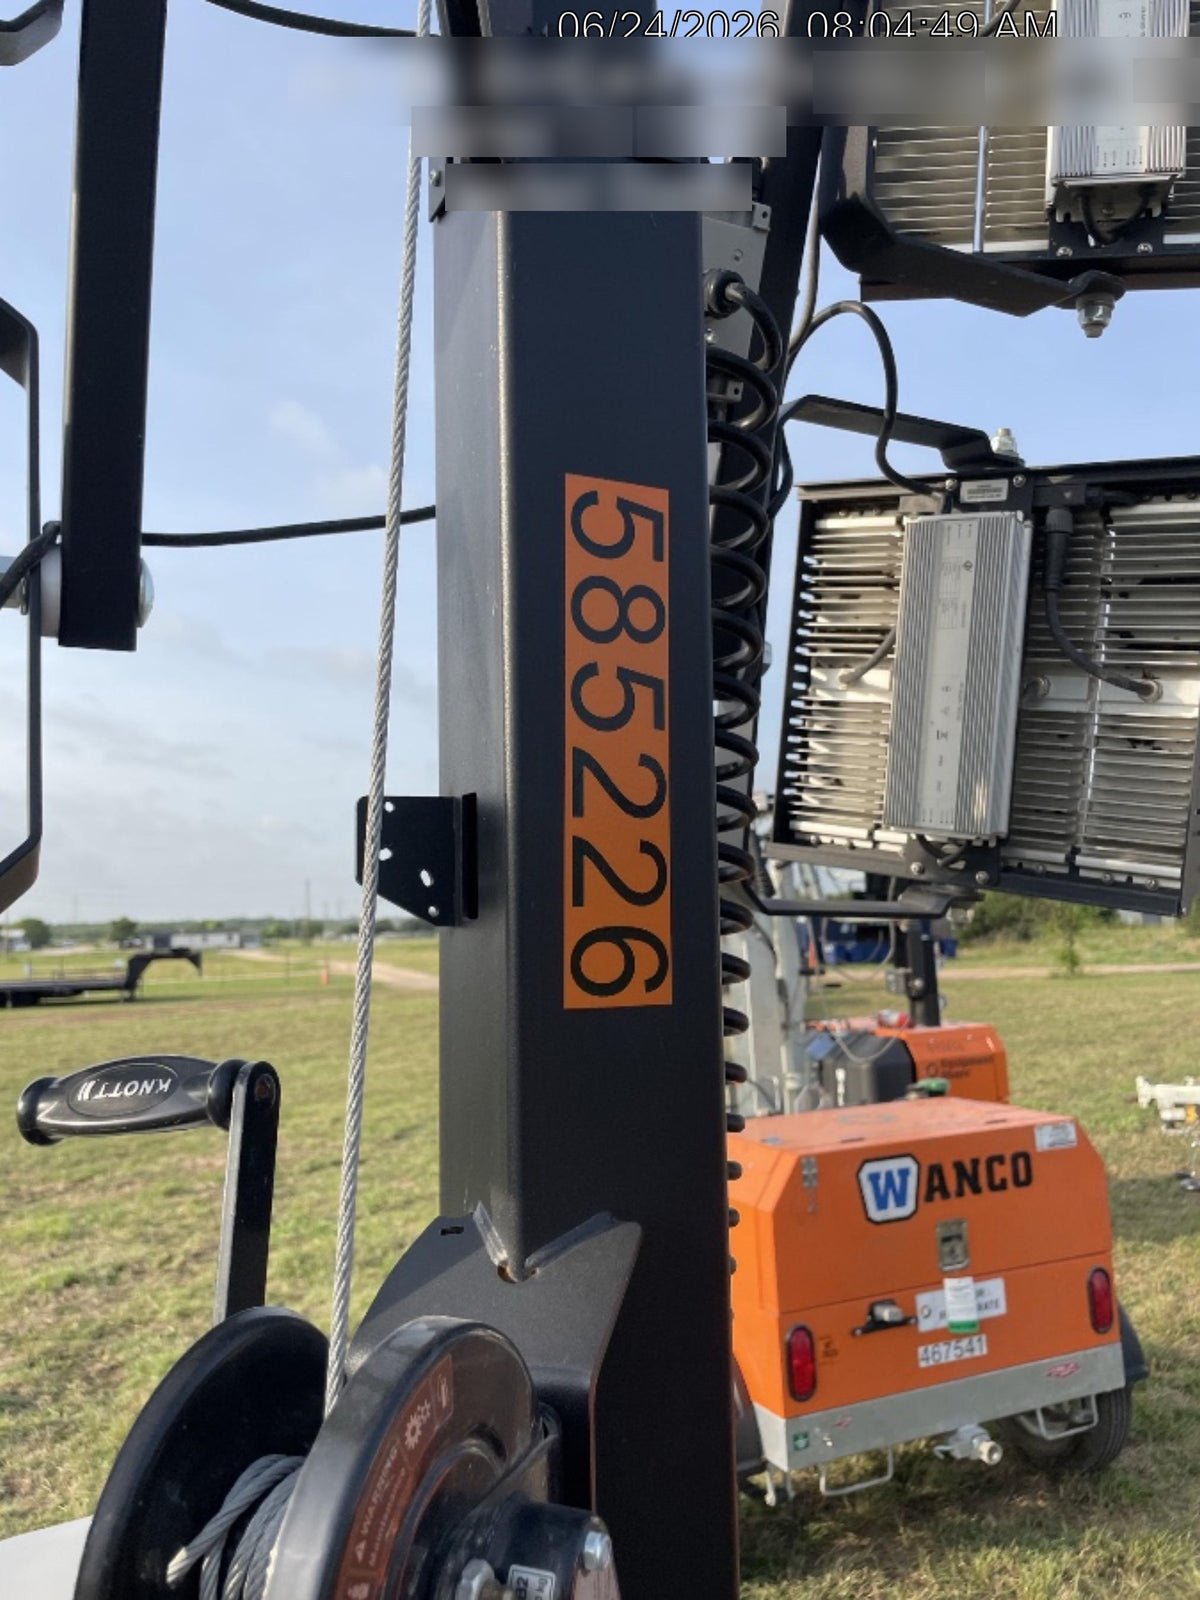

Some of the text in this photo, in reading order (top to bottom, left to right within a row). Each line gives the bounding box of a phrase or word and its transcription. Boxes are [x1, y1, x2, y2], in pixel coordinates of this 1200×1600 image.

[570, 490, 669, 997] 585226
[93, 1078, 172, 1100] KNOTT
[868, 1151, 1033, 1211] WANCO
[921, 1336, 984, 1364] 467541
